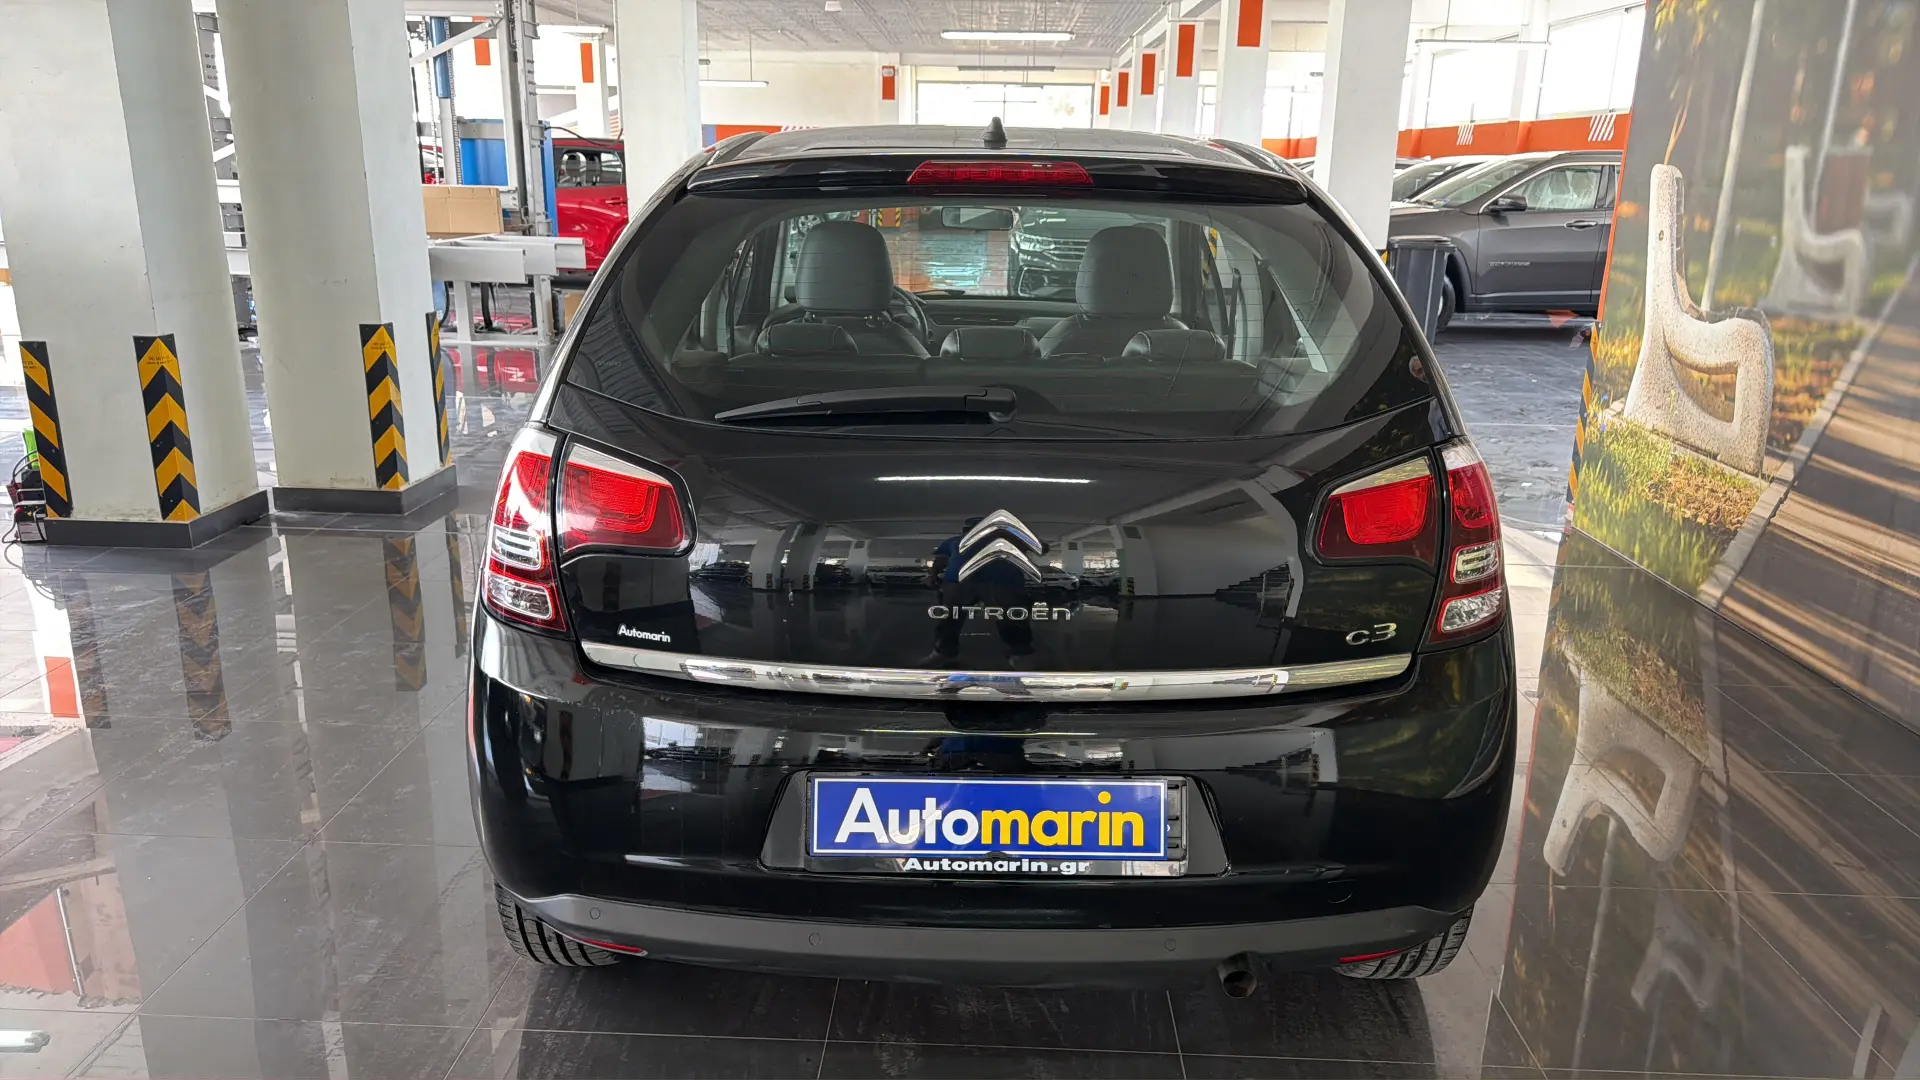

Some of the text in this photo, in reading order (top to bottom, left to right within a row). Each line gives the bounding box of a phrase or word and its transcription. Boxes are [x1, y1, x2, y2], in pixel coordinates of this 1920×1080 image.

[618, 624, 671, 643] Automarin
[1346, 623, 1397, 645] C3
[834, 787, 1145, 846] Automarin
[903, 857, 1090, 875] Automarin.gr
